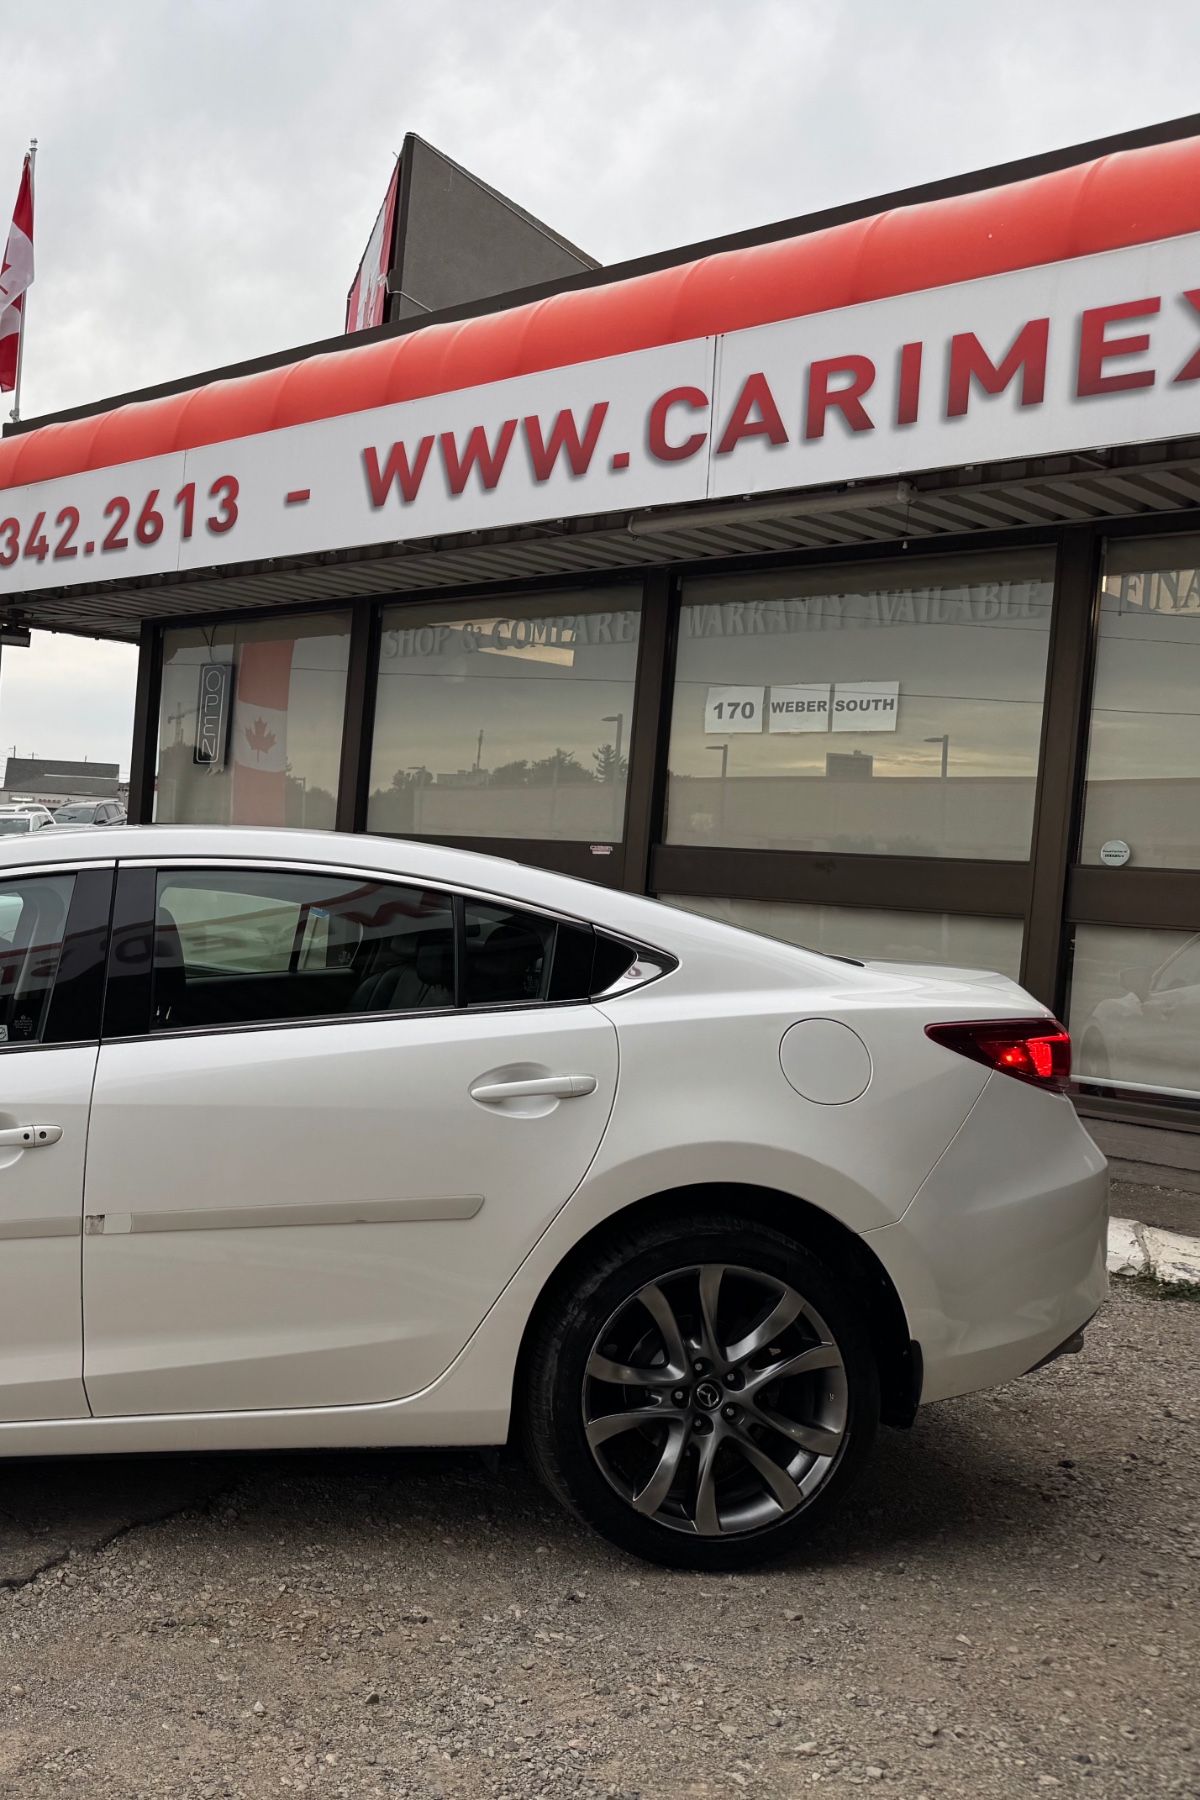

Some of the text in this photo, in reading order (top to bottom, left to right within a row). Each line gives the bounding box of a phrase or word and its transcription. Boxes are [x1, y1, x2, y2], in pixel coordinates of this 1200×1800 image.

[384, 610, 637, 658] SHOP & COMPARE
[686, 579, 1041, 637] WARRANTY AVAILABLE
[201, 670, 221, 757] OPEN
[713, 698, 895, 719] 170 WEBER SOUTH
